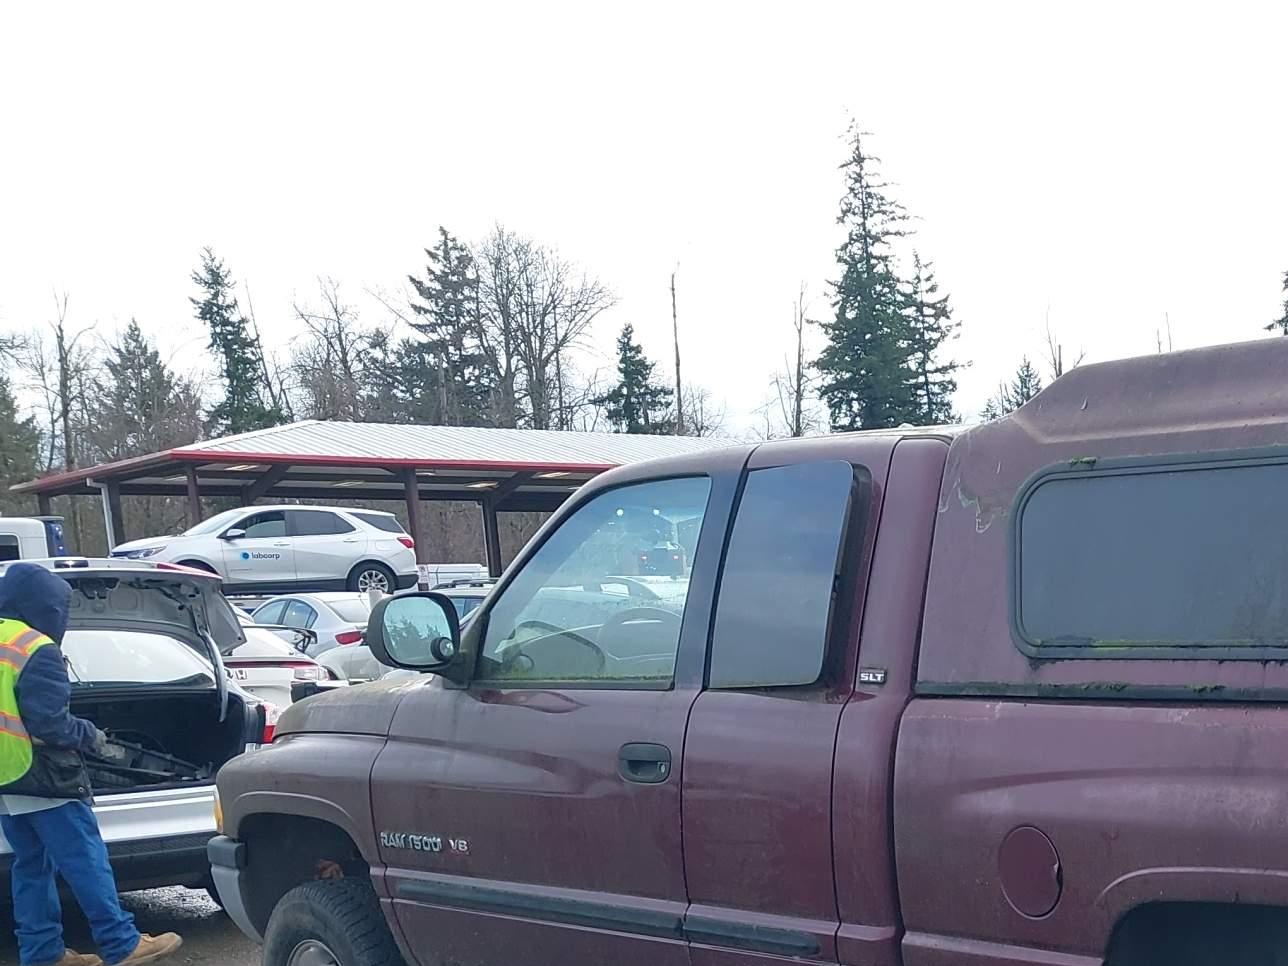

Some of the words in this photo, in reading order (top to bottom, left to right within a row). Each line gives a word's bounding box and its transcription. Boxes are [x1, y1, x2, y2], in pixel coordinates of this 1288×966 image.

[251, 551, 281, 561] labcorp
[860, 673, 884, 682] SLT
[380, 832, 406, 848] RAM
[408, 834, 442, 852] 1500
